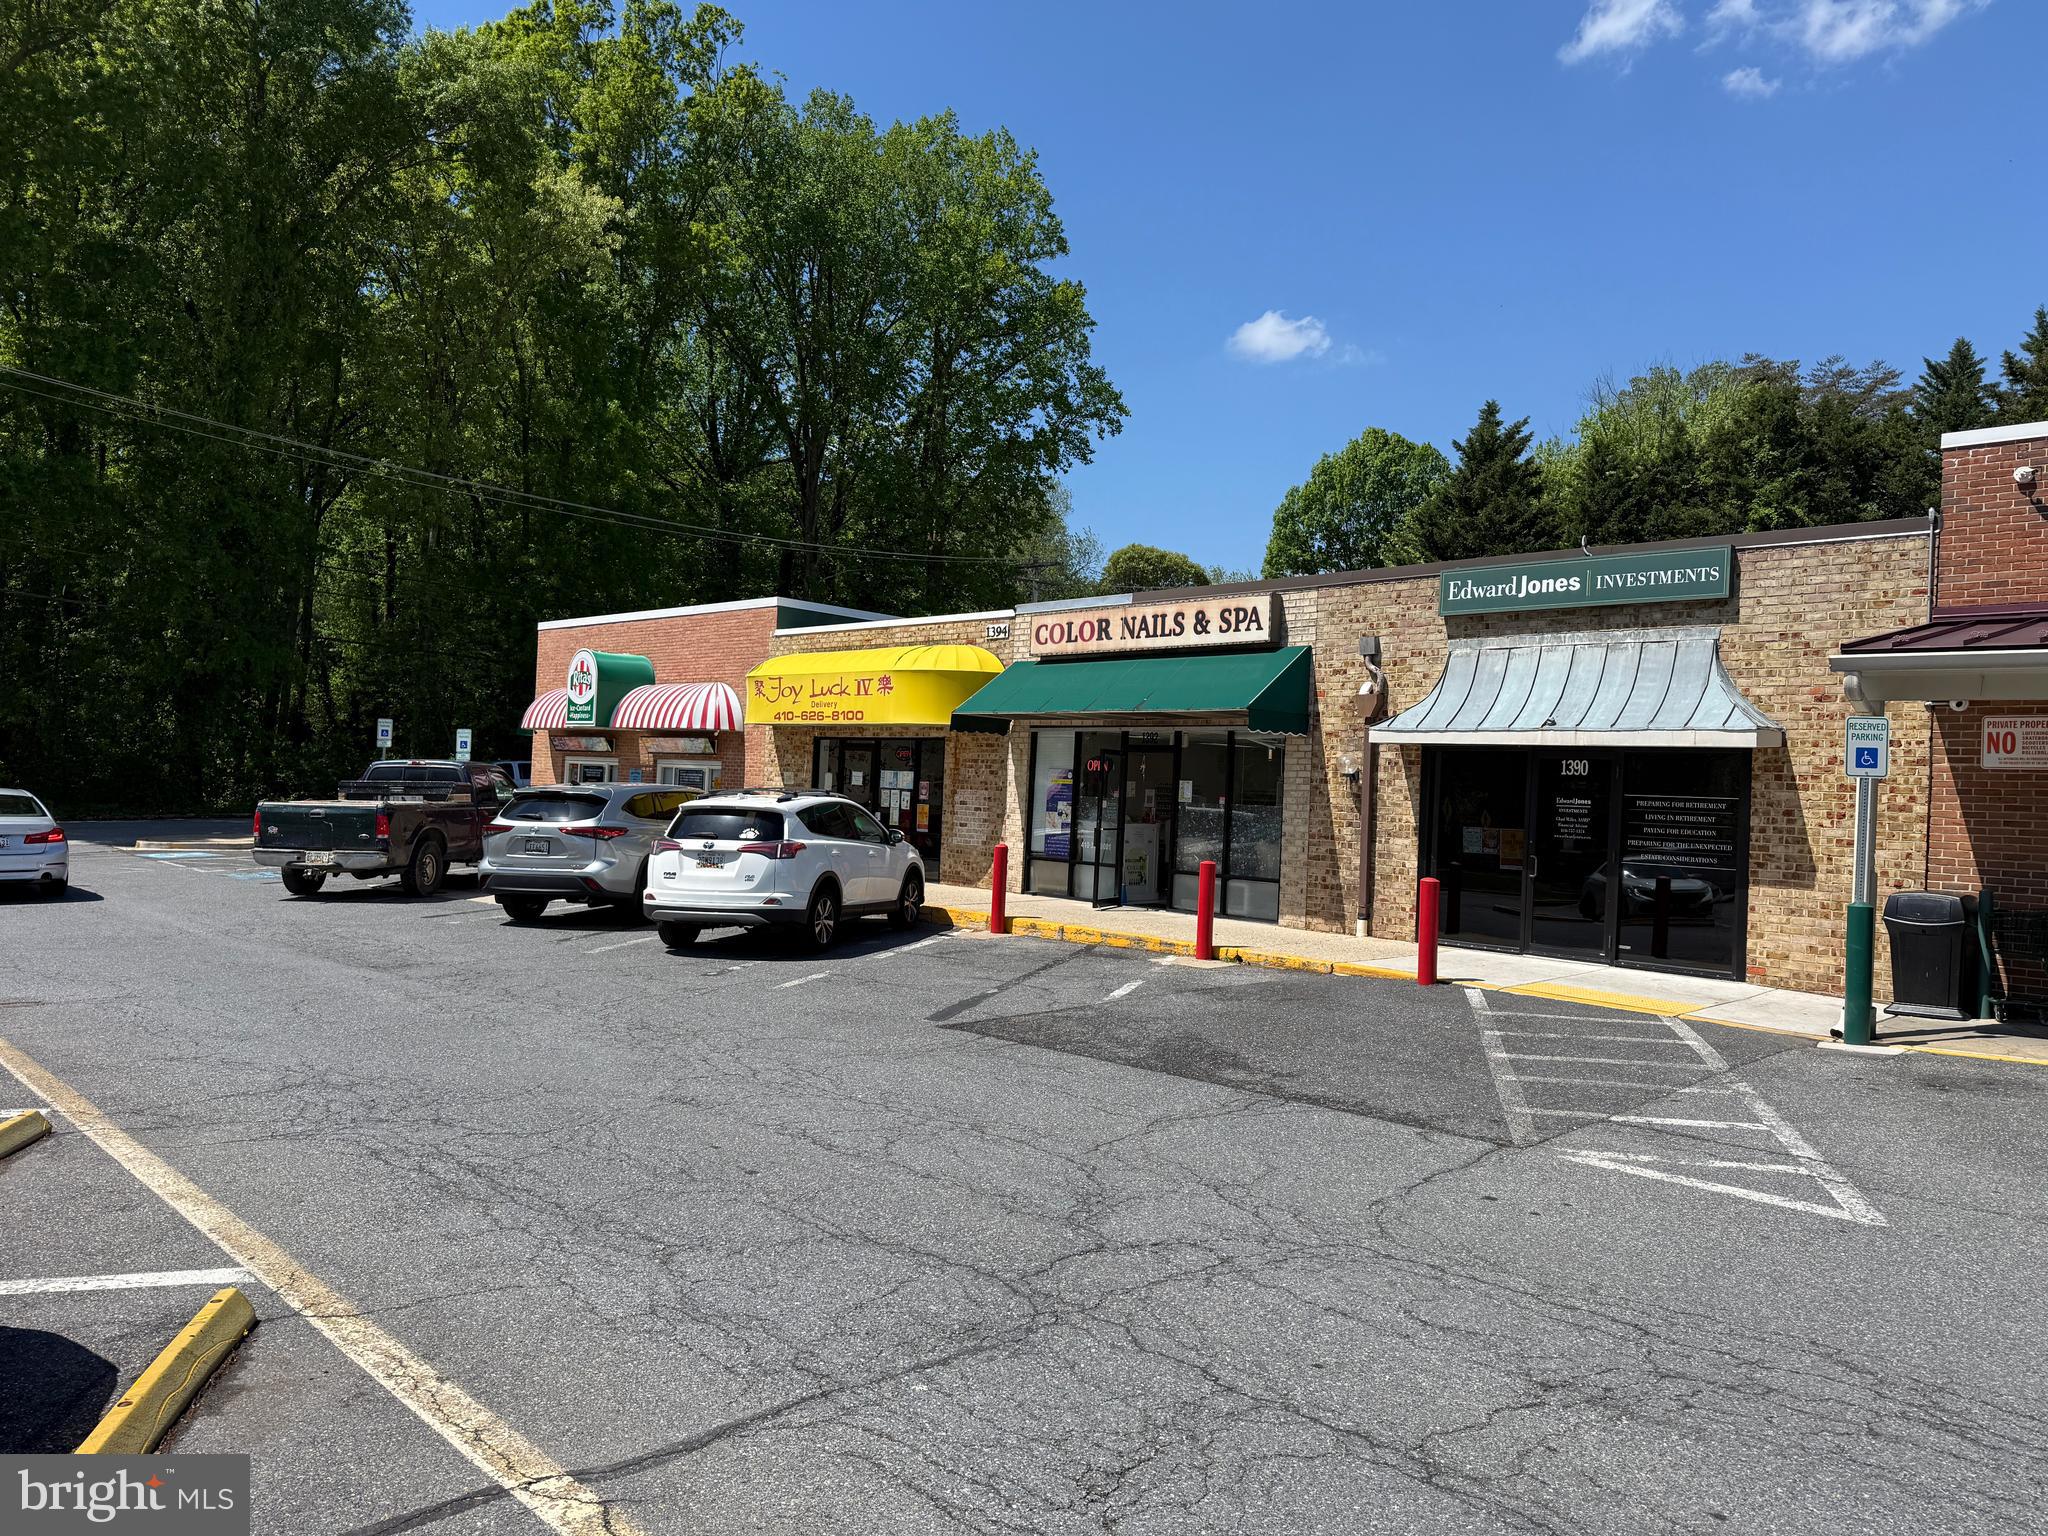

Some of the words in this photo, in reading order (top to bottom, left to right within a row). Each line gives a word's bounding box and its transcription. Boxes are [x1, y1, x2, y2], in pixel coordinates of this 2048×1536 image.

[1596, 566, 1720, 589] INVESTMENTS
[1035, 618, 1112, 646] COLOR
[1120, 611, 1185, 640] NAILS
[1193, 610, 1211, 635] &
[1219, 606, 1263, 634] SPA
[986, 626, 1008, 638] 1394
[766, 677, 803, 704] Joy
[809, 677, 851, 698] Luck
[855, 678, 874, 696] IV
[811, 701, 838, 709] Delivery
[774, 711, 864, 721] 410-626-8100
[1849, 722, 1887, 731] RESERVED
[1987, 720, 2018, 729] PRIVATE
[1851, 733, 1884, 741] PARKING
[1986, 731, 2016, 754] NO
[1561, 760, 1589, 775] 1390
[1675, 815, 1716, 823] RETIREMENT
[1680, 828, 1717, 836] EDUCATION
[1627, 839, 1662, 847] PREPARING
[1690, 842, 1733, 851] UNEXPECTED
[1640, 853, 1662, 861] ESTATE
[1662, 855, 1718, 864] CONSIDERATIONS
